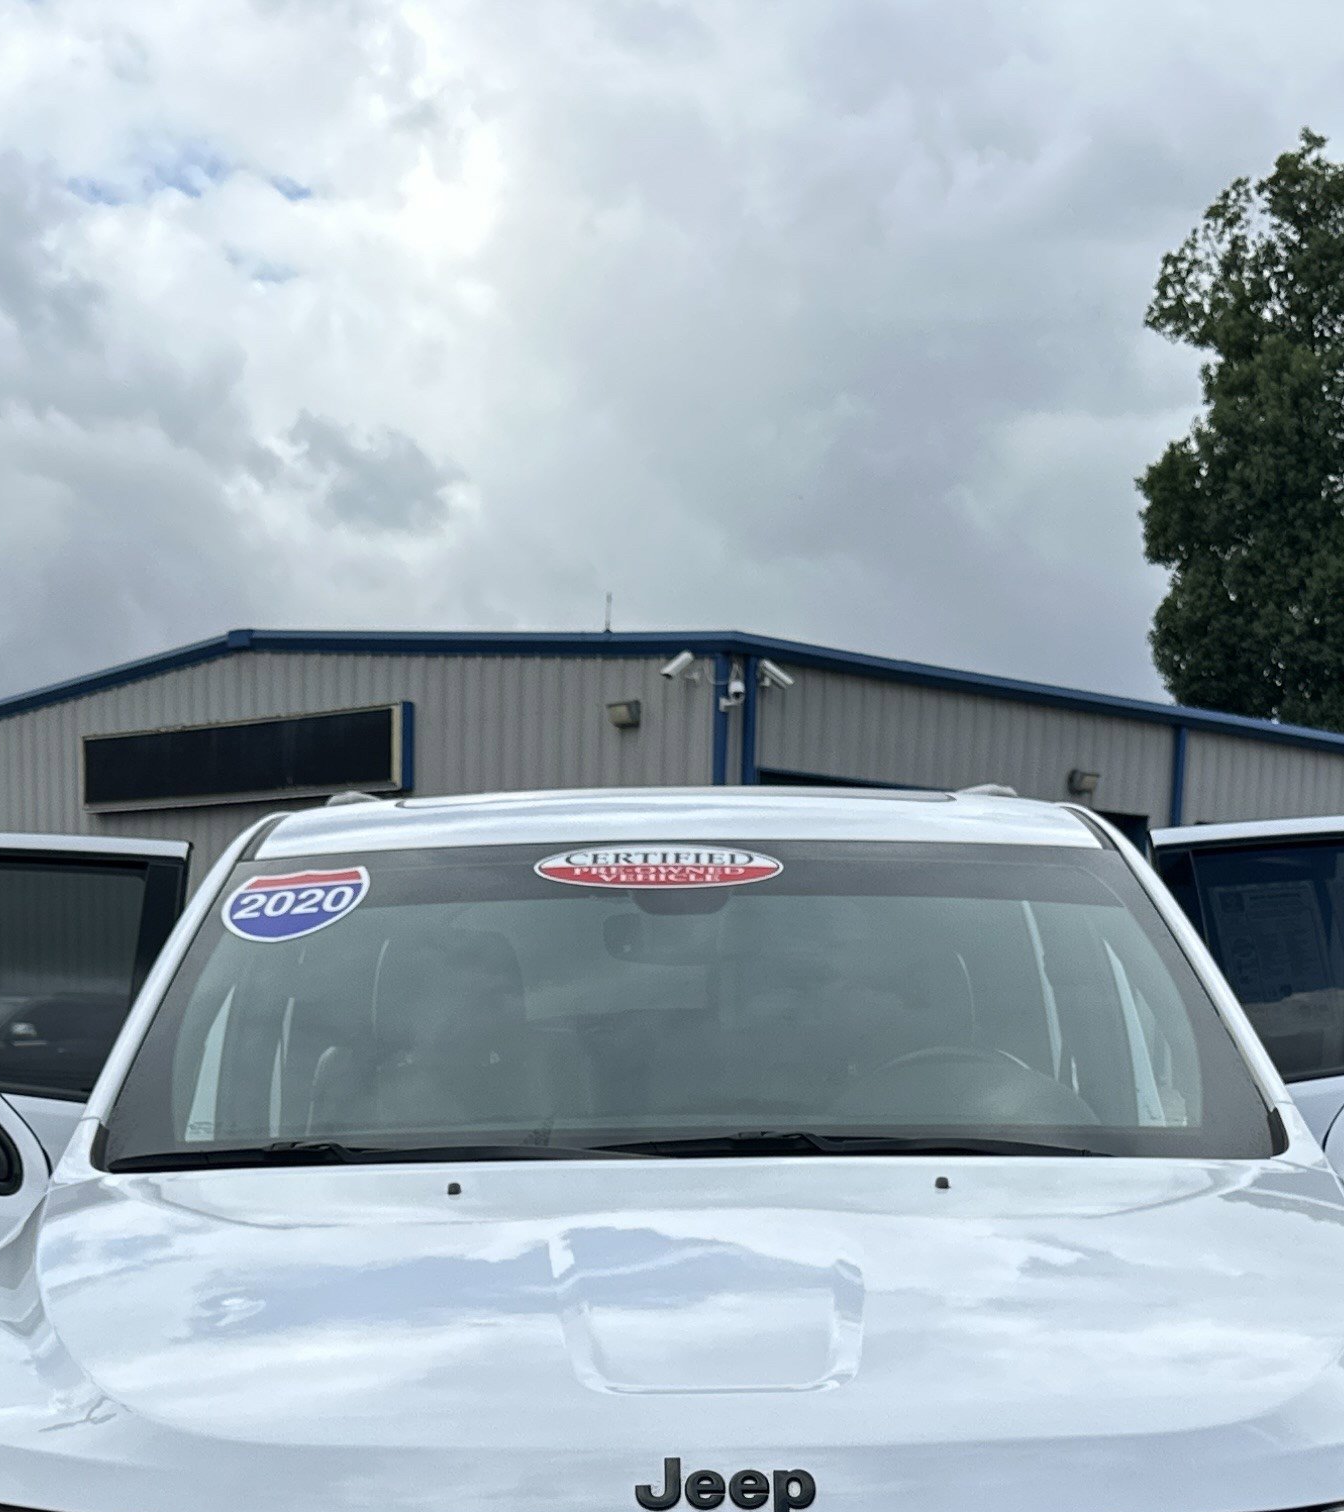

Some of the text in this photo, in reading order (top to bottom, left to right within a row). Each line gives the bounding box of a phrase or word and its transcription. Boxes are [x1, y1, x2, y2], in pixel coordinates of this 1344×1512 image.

[565, 851, 754, 866] CERTIFIED
[573, 866, 745, 876] PRE-OWNED
[599, 873, 721, 883] VEHICLE
[232, 886, 355, 920] 2020
